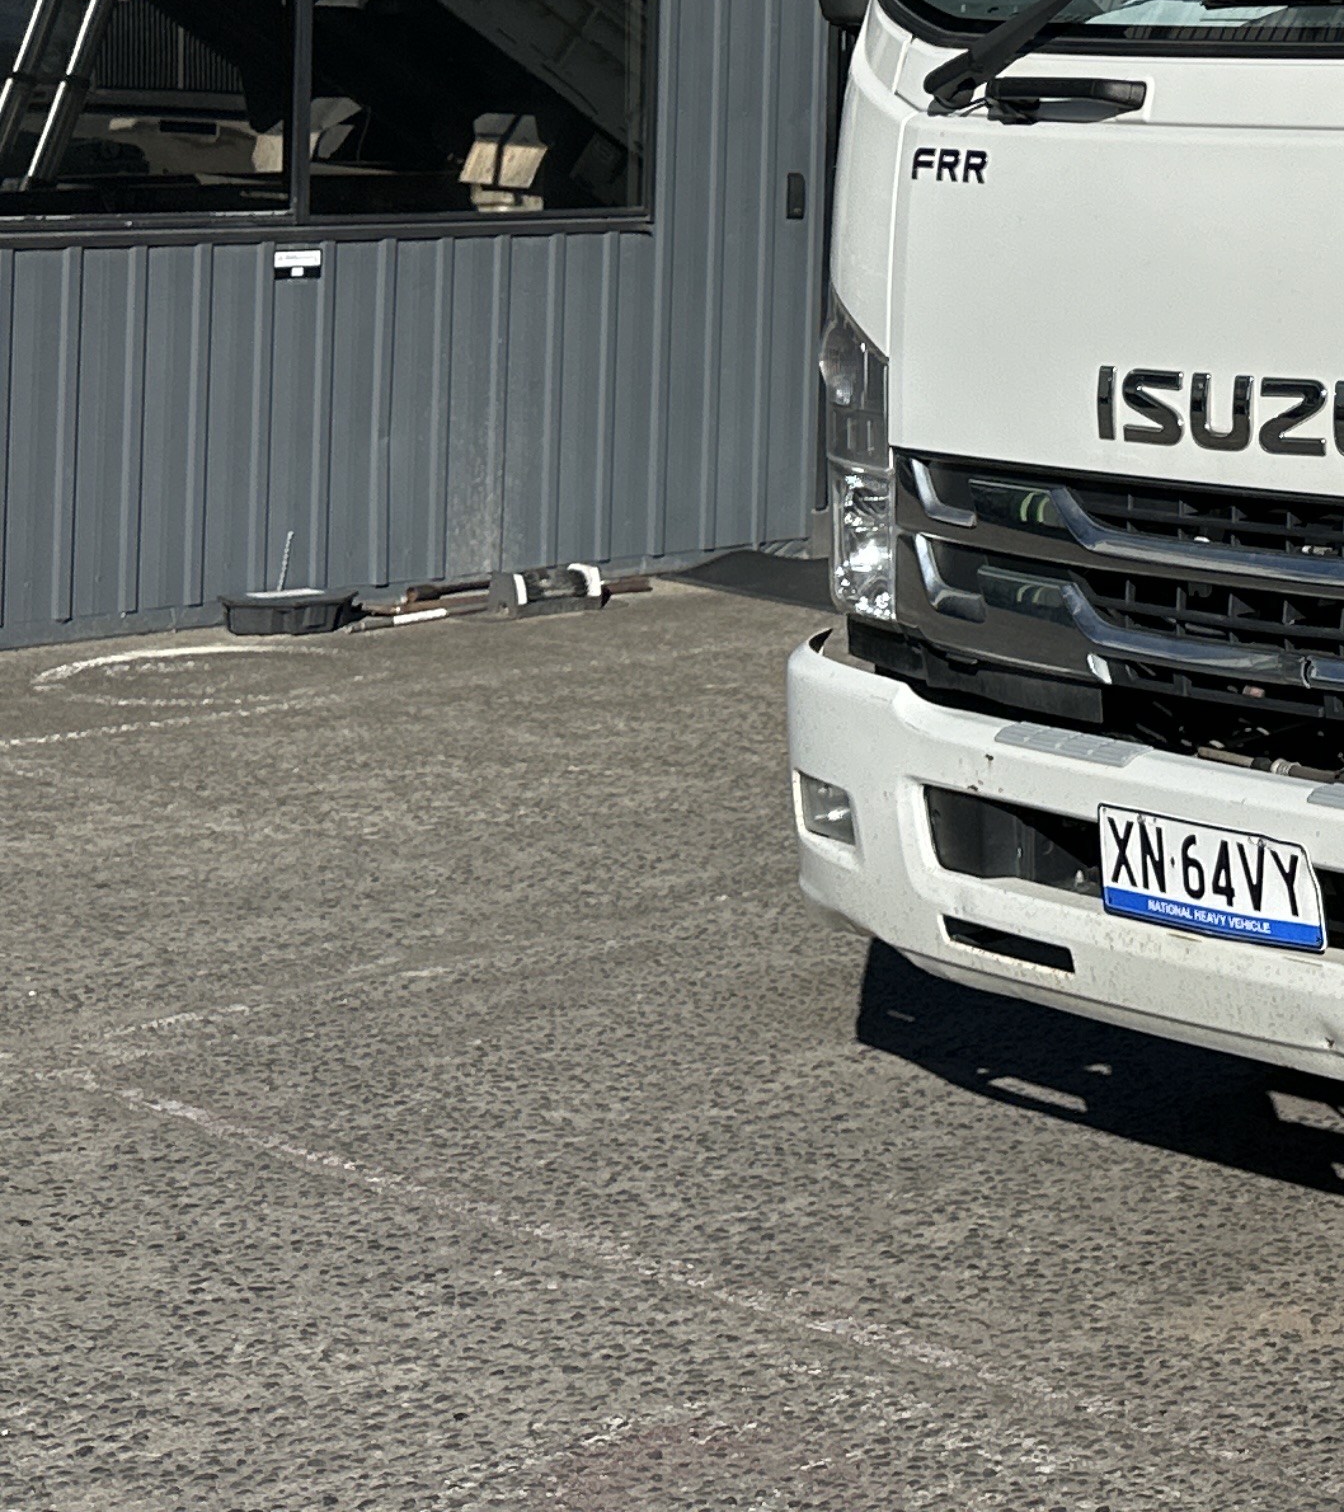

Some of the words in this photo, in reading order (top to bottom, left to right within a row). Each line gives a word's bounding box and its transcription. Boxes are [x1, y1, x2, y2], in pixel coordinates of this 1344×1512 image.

[911, 145, 989, 184] FRR
[1147, 899, 1193, 921] NATIONAL
[1194, 909, 1227, 929] HEAVY
[1228, 916, 1271, 935] VEHICLE
